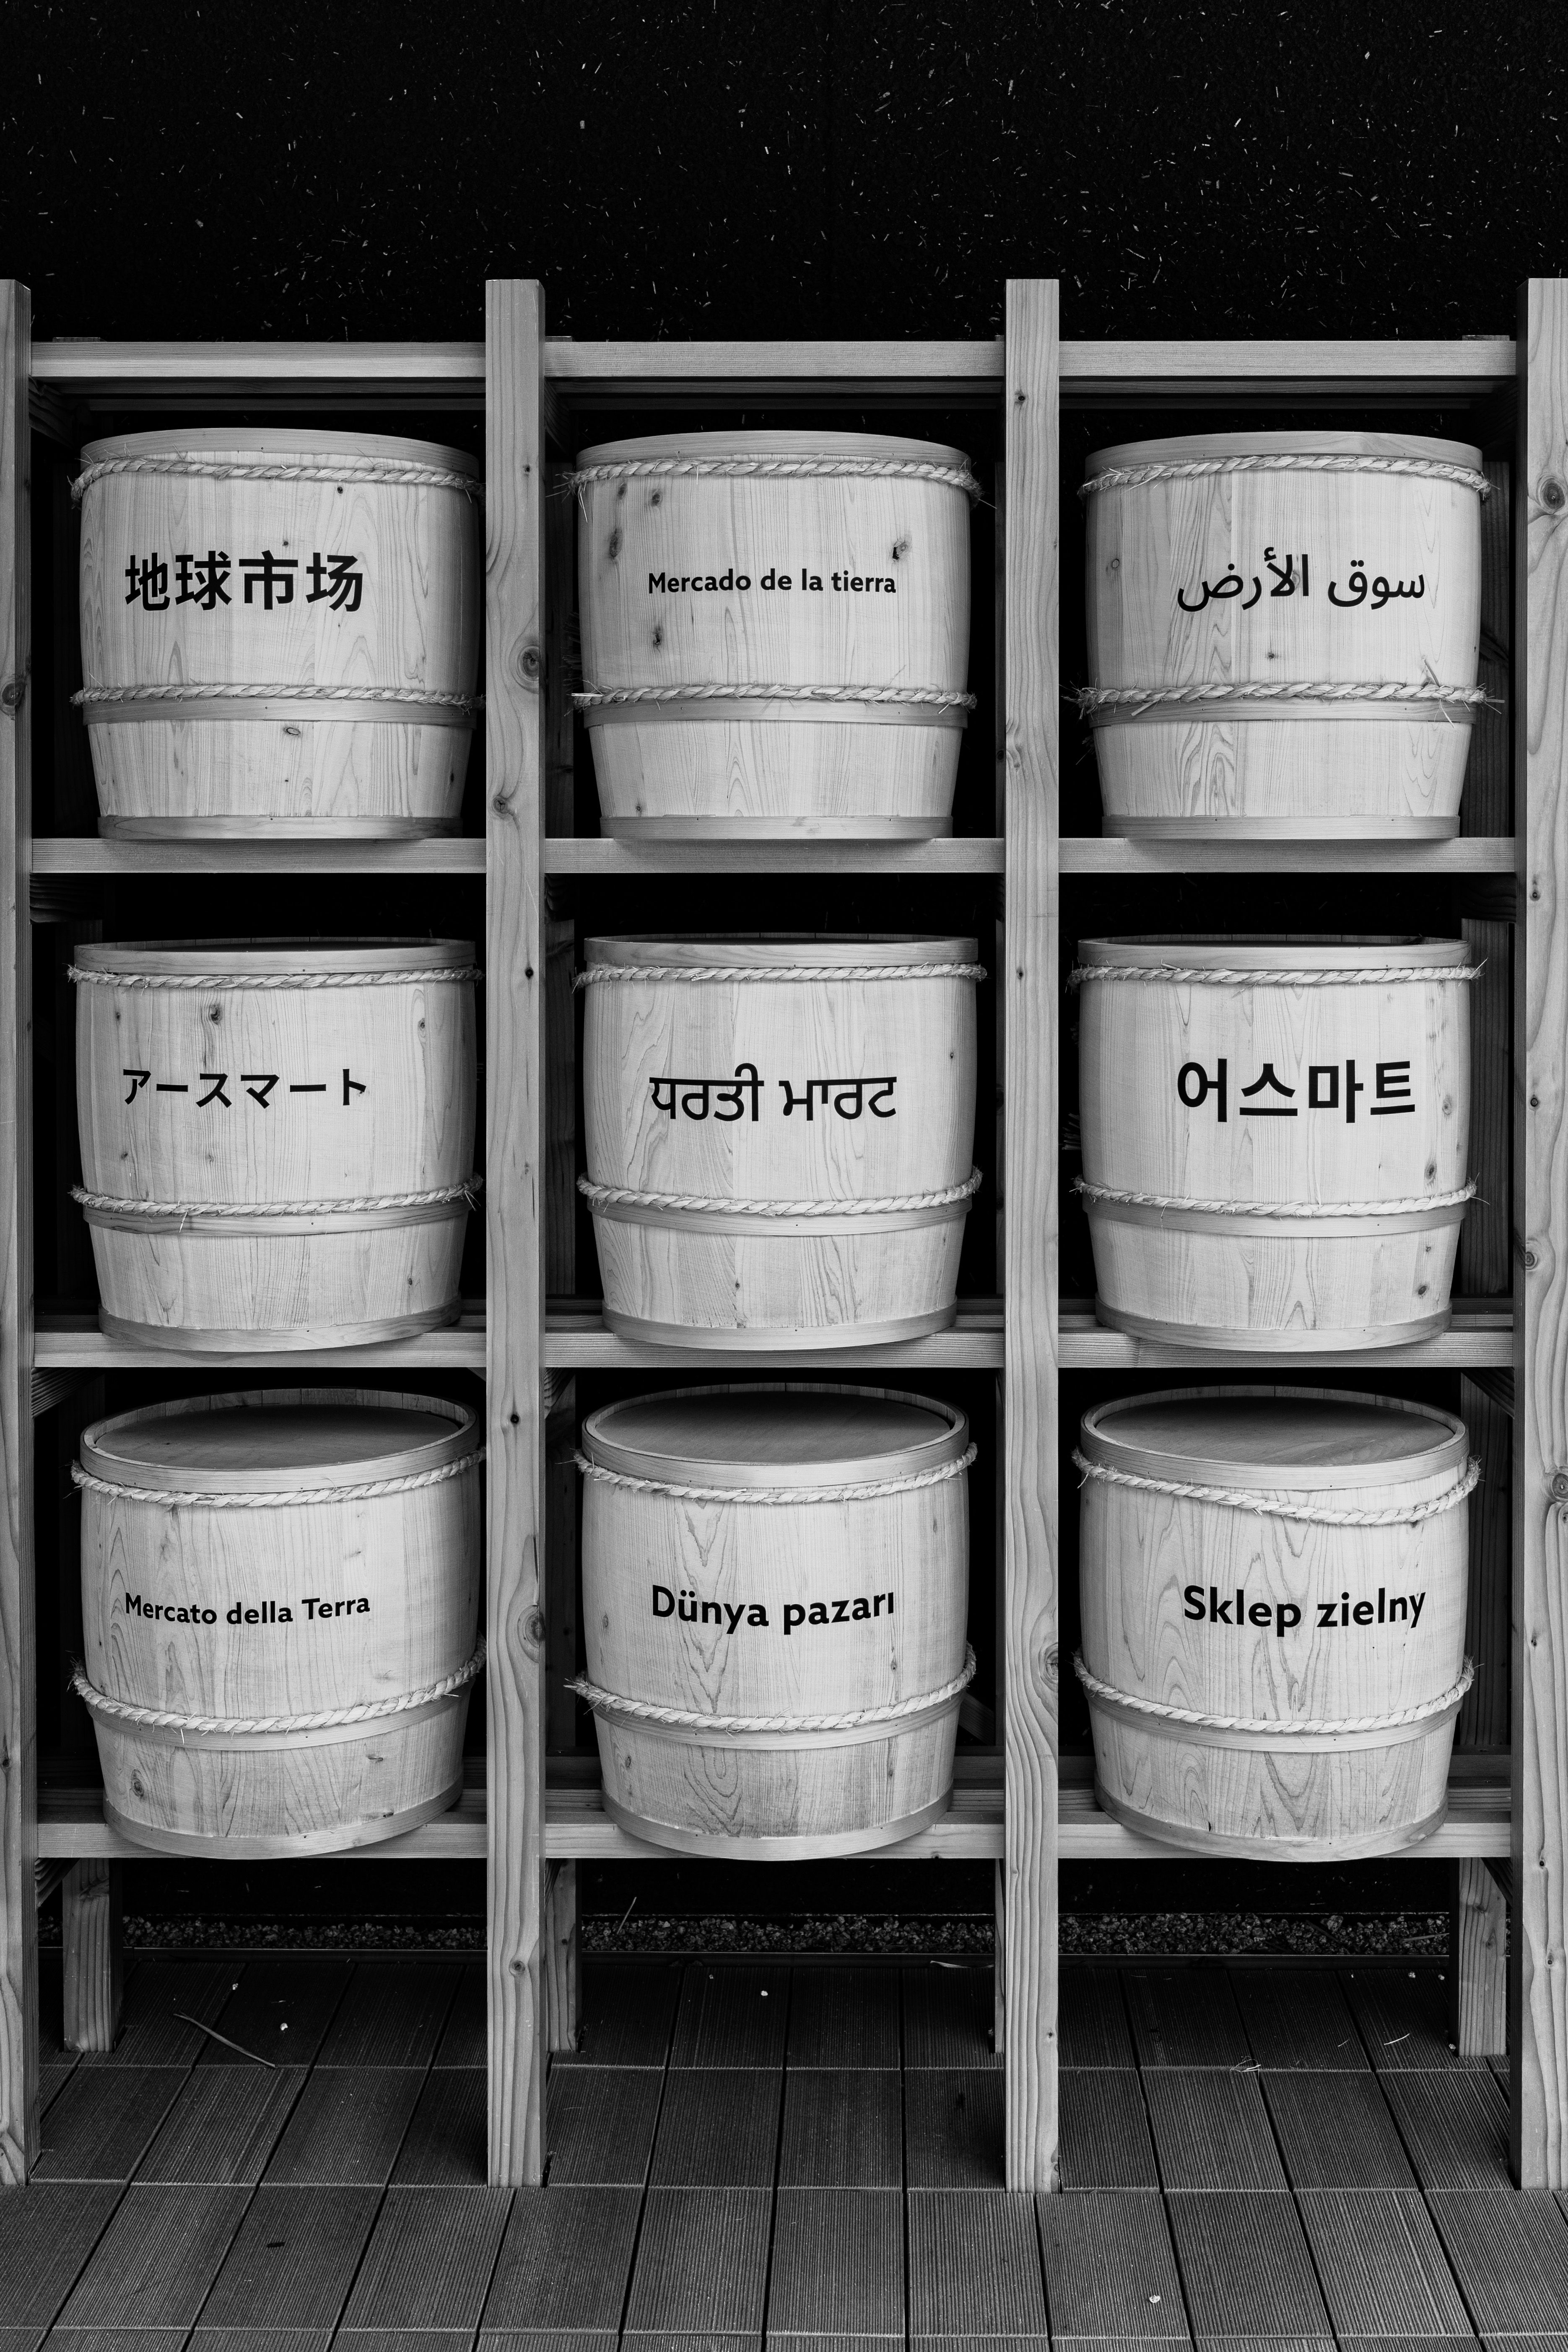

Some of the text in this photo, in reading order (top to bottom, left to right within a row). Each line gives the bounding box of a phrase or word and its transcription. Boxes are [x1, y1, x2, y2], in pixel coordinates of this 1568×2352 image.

[125, 550, 363, 612] 地球市场
[649, 569, 896, 594] Mercado de la tierra
[1177, 547, 1425, 612] سوق الأرض
[123, 1069, 367, 1109] アースマート
[649, 1063, 897, 1121] ਧਰਤੀ ਮਾਰਟ
[1177, 1058, 1415, 1123] 어스마트
[125, 1592, 370, 1625] Mercato della Terra
[652, 1584, 894, 1635] Dünya pazarı
[1184, 1585, 1426, 1637] Sklep zielny
